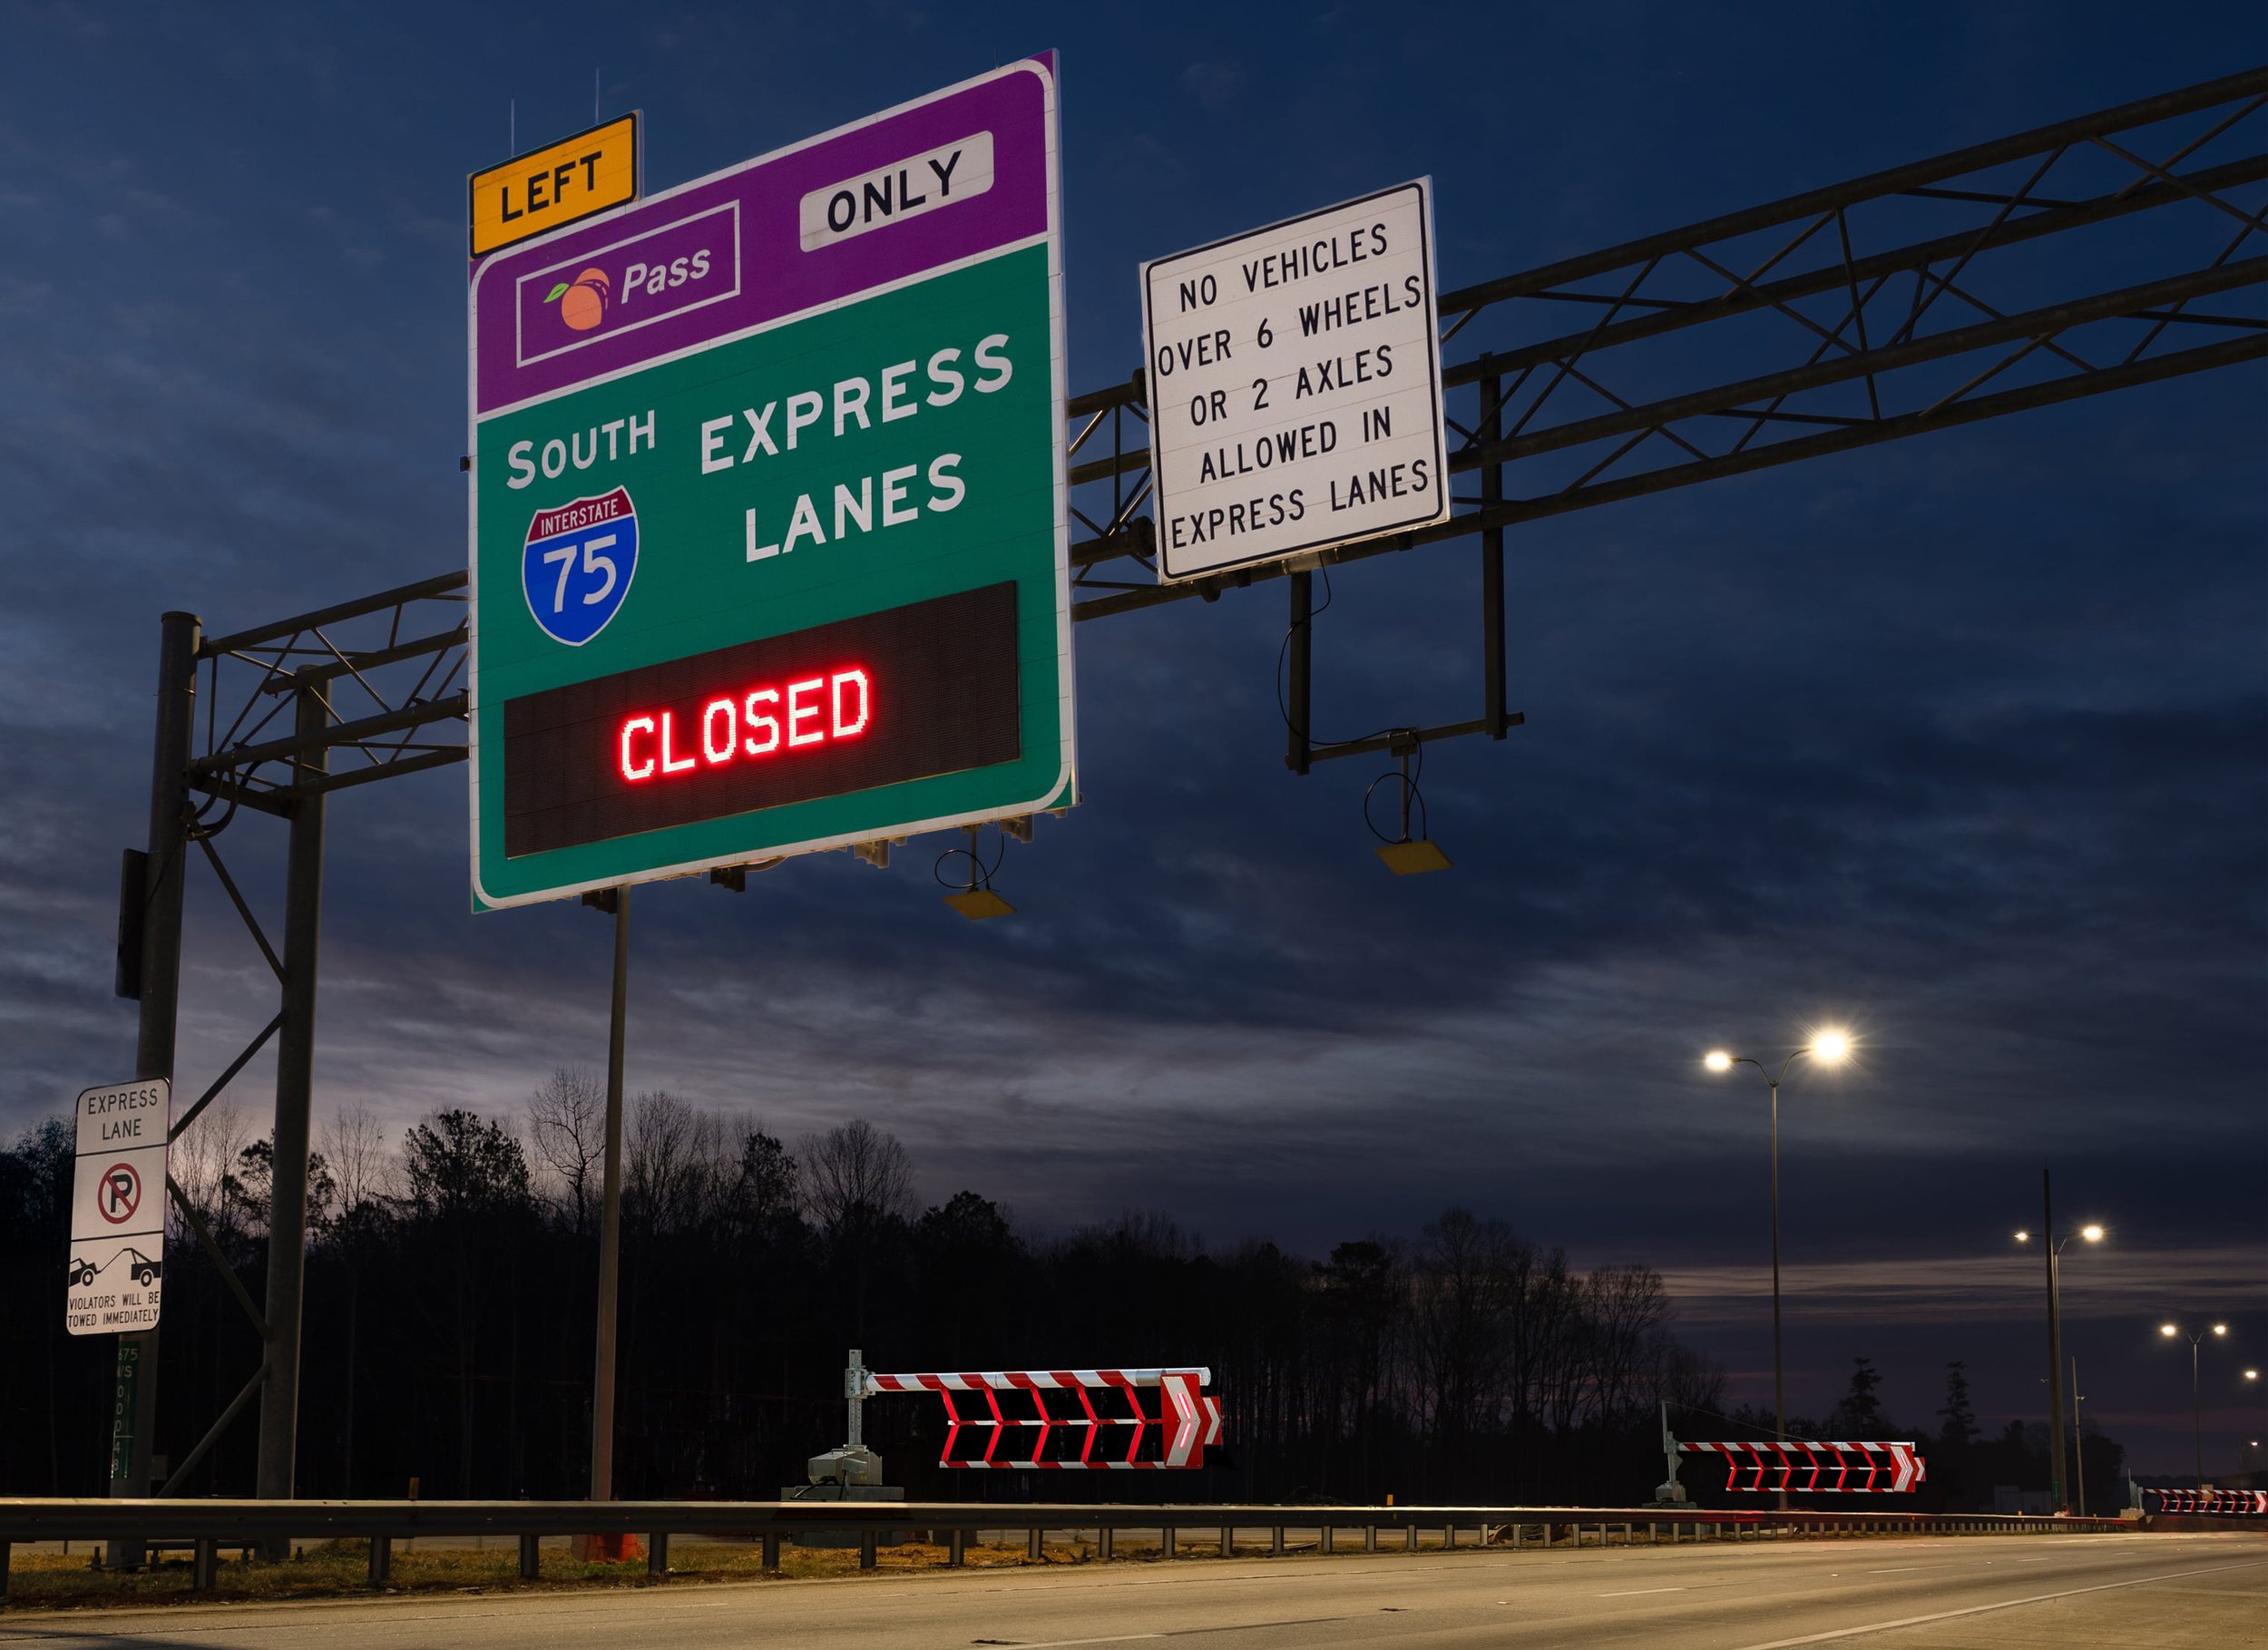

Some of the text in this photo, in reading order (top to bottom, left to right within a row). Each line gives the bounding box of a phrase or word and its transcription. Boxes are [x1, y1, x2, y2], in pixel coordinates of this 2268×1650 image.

[501, 151, 602, 223] LEFT
[826, 150, 963, 233] ONLY
[621, 248, 711, 304] Pass
[1179, 223, 1388, 313] NO VEHICLES
[1158, 275, 1422, 376] OVER 6 WHEELS
[701, 334, 1013, 474] EXPRESS
[1190, 345, 1393, 426] OR 2 AXLES
[506, 410, 656, 490] SOUTH
[1199, 405, 1392, 483] ALLOWED IN
[540, 497, 619, 536] INTERSTATE
[745, 454, 966, 562] LANES
[1171, 459, 1429, 549] EXPRESS LANES
[543, 533, 617, 613] 75
[621, 668, 869, 781] CLOSED
[88, 1089, 158, 1115] EXPRESS
[102, 1118, 142, 1140] LANE
[68, 1308, 159, 1327] TOWED IMMEDIATELY
[69, 1291, 160, 1310] VIOLATORS WILL BE
